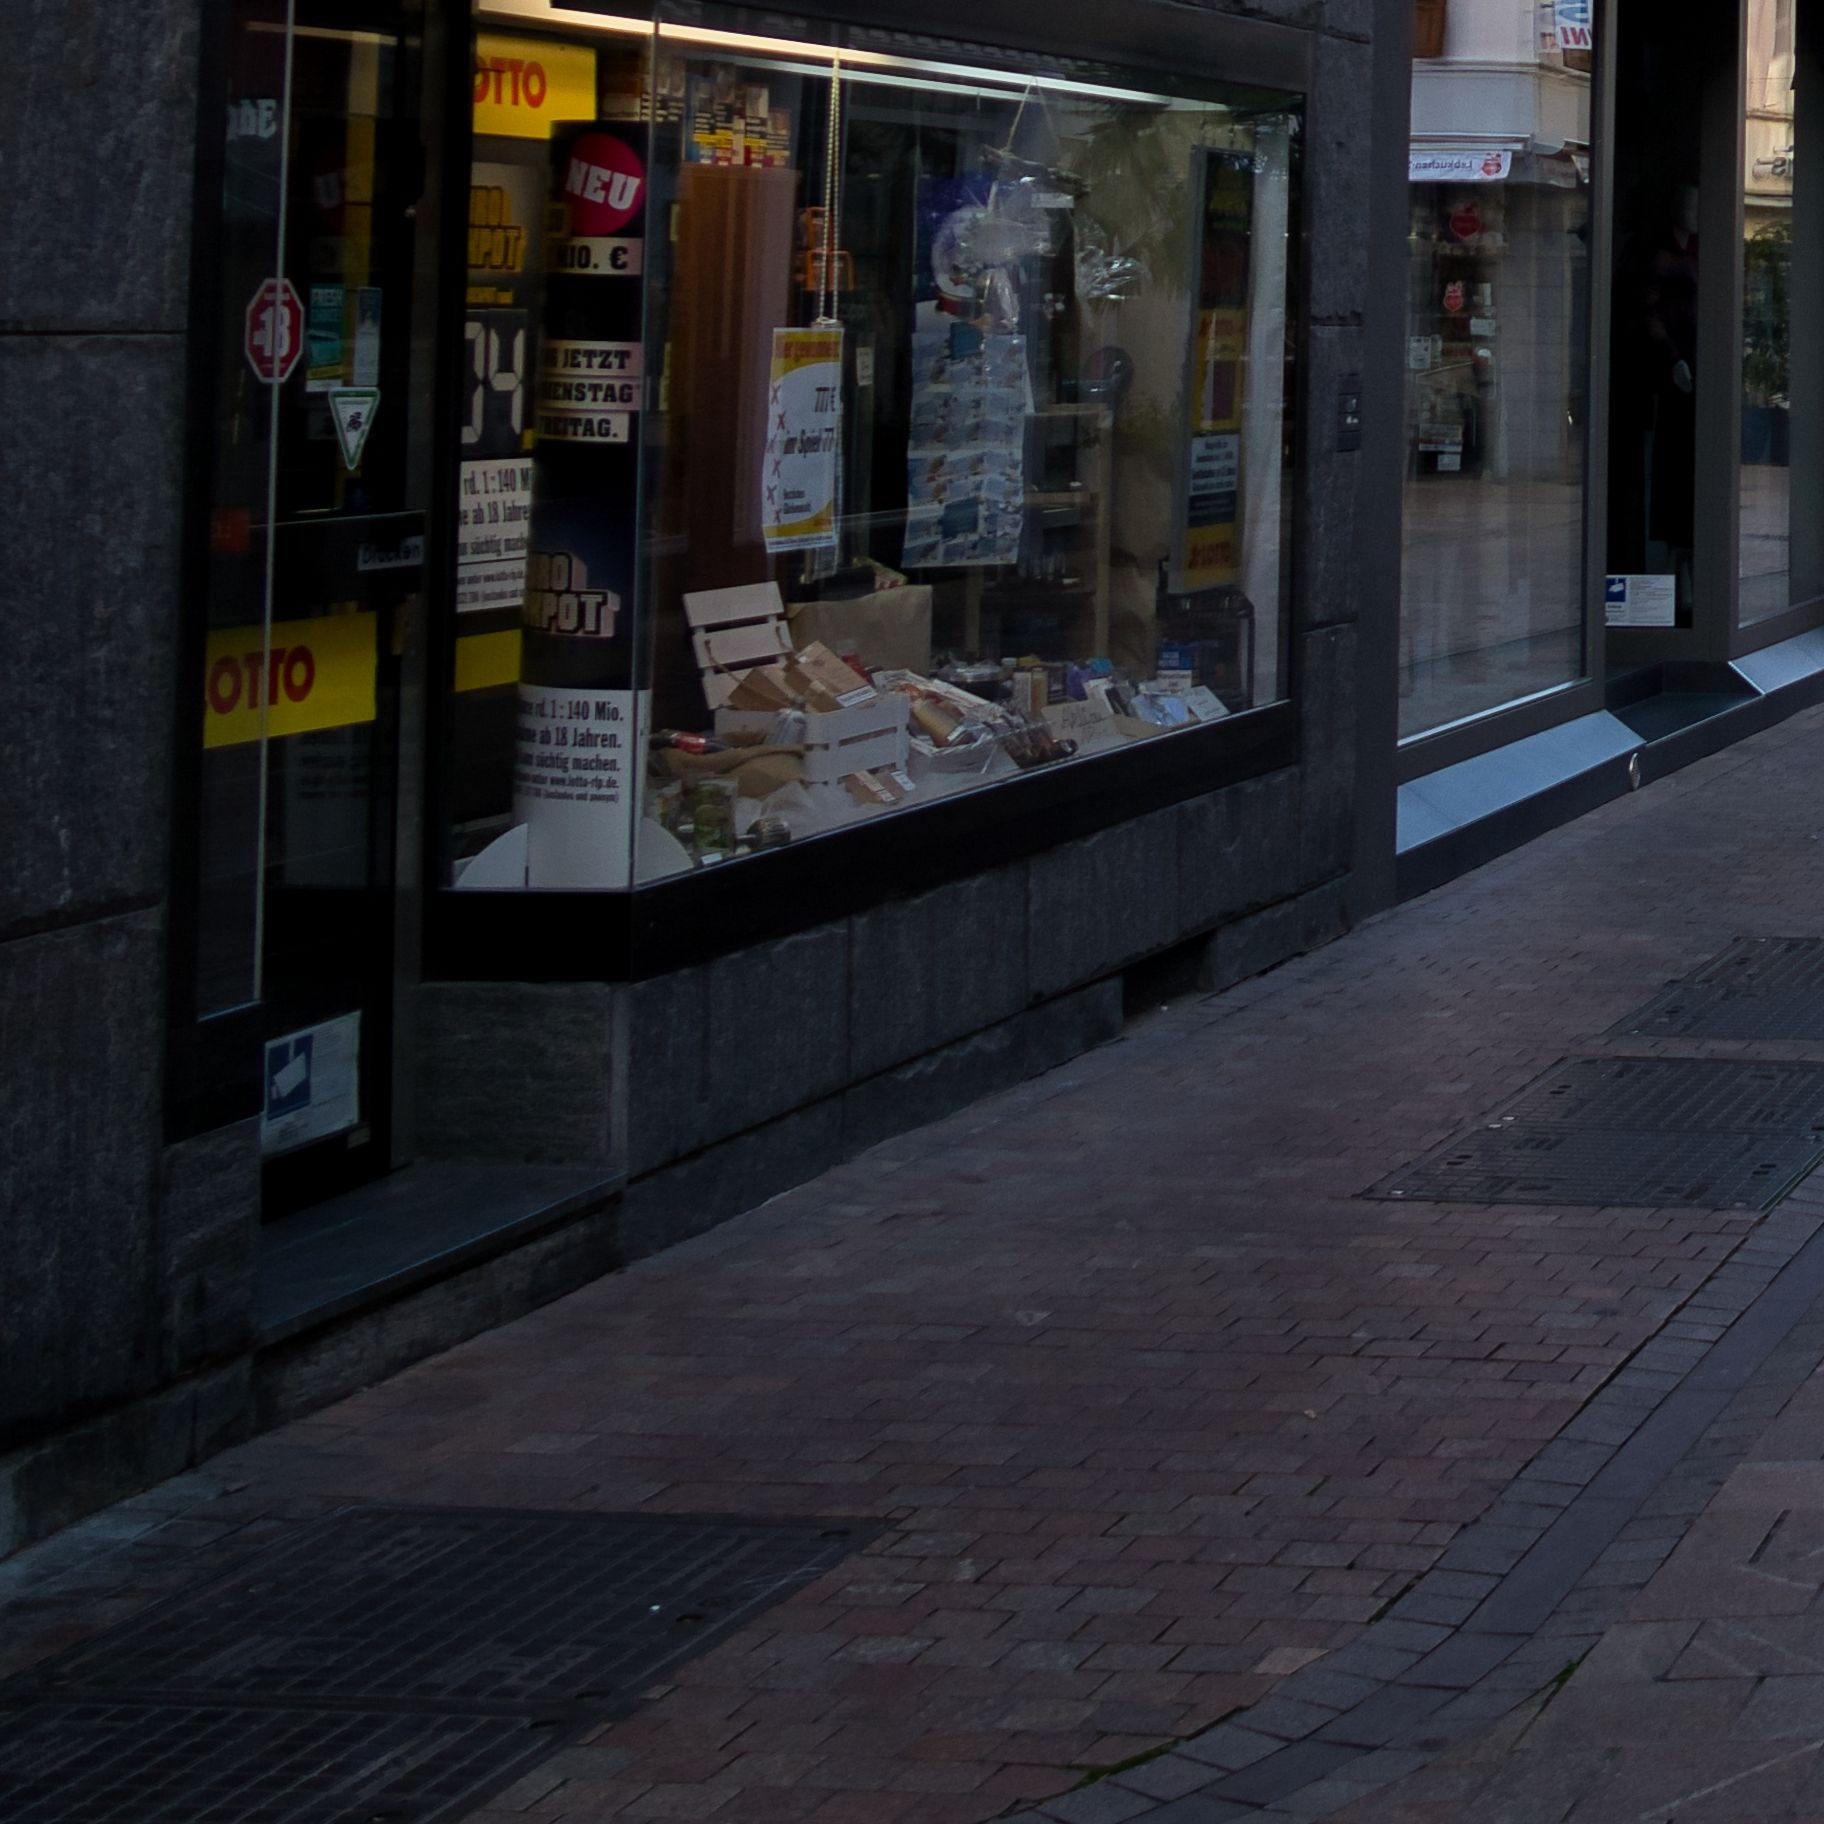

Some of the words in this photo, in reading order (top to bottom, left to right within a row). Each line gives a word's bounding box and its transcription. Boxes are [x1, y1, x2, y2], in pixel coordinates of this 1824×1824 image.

[471, 57, 547, 109] OTTO
[563, 156, 641, 211] NEU
[542, 377, 634, 404] ENSTAG
[502, 497, 531, 523] Jahre
[207, 644, 316, 715] OTTO
[594, 700, 624, 722] Mio.
[572, 727, 622, 749] Jahren.
